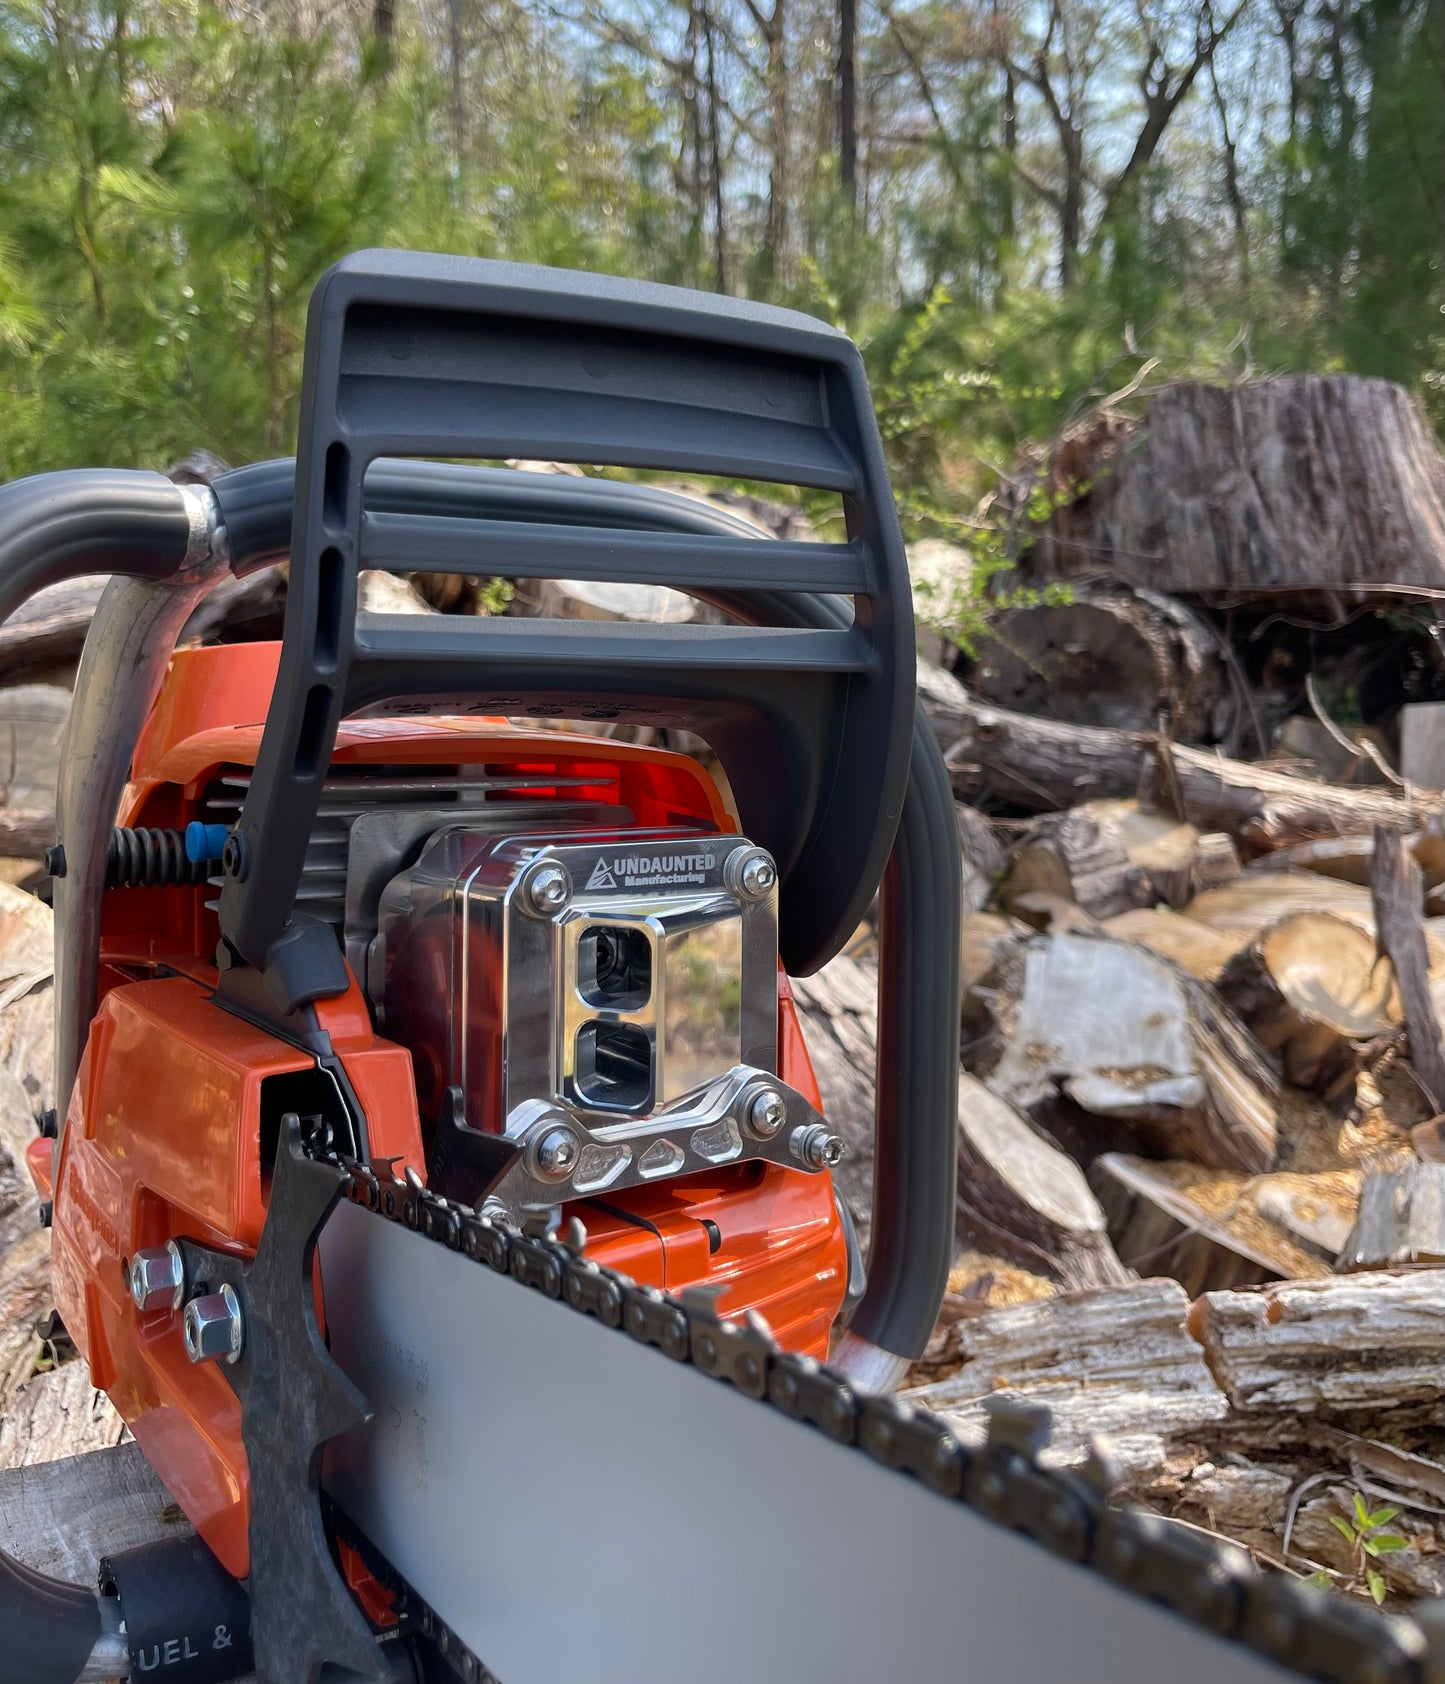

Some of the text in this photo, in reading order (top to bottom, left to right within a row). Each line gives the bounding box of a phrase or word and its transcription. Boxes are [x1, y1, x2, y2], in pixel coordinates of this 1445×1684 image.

[614, 854, 716, 875] UNDAUNTED
[624, 872, 706, 887] Manufacturing
[132, 1625, 232, 1671] UEL &
